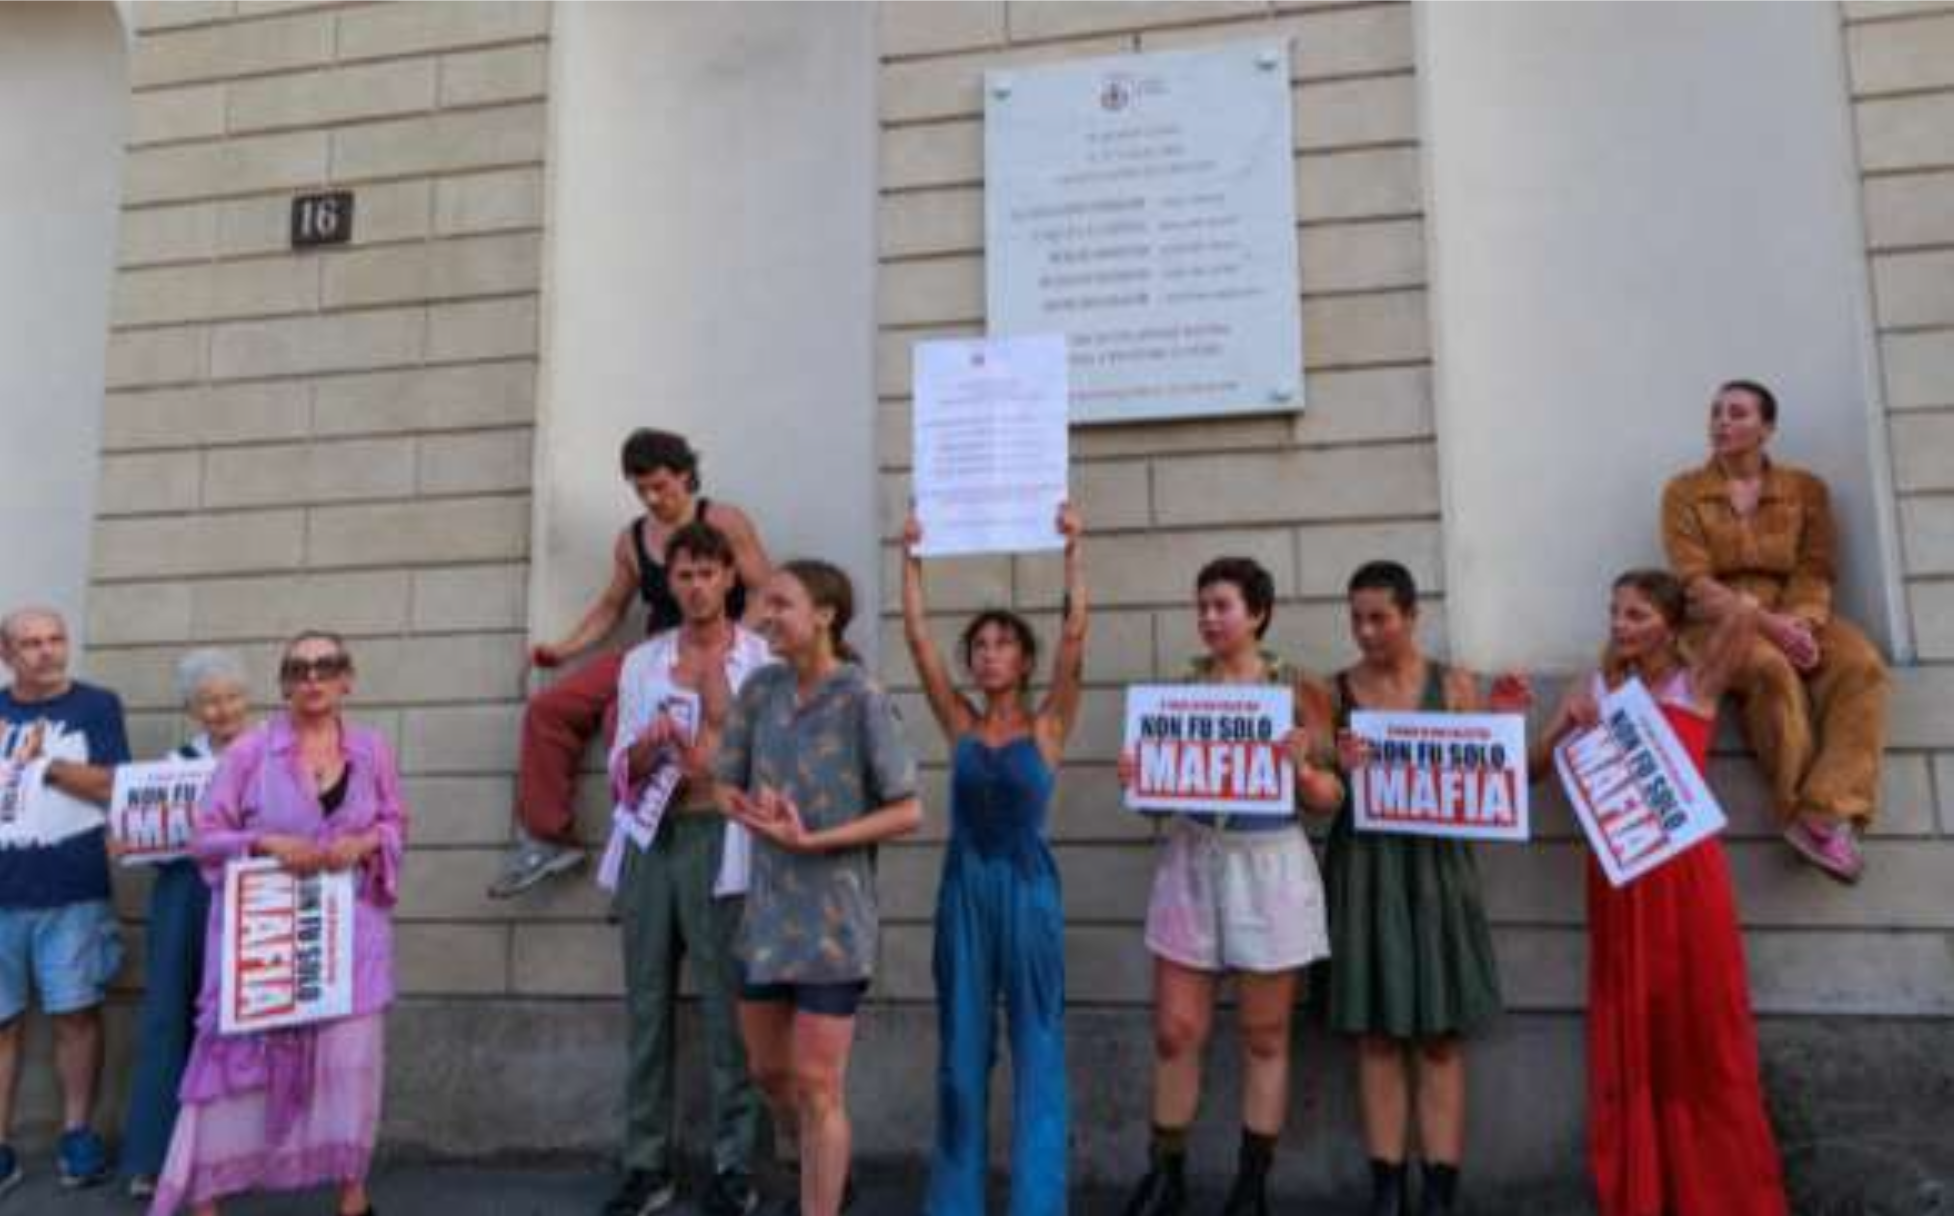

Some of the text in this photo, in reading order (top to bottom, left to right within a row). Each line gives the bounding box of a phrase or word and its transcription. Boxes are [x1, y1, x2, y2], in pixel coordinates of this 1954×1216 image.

[302, 199, 338, 237] 16
[1140, 714, 1273, 739] NON FU SOLO
[1138, 741, 1280, 799] MAFIA
[1417, 740, 1443, 769] FU
[1450, 742, 1506, 772] SOLO
[1612, 707, 1642, 750] NON
[1647, 775, 1687, 830] SOLO
[127, 782, 197, 806] NON FU
[1367, 765, 1516, 825] MAFIA
[1566, 724, 1669, 866] MAFIA
[237, 872, 294, 1019] MAFIA
[298, 915, 322, 942] FU
[297, 946, 322, 1002] SOLO
